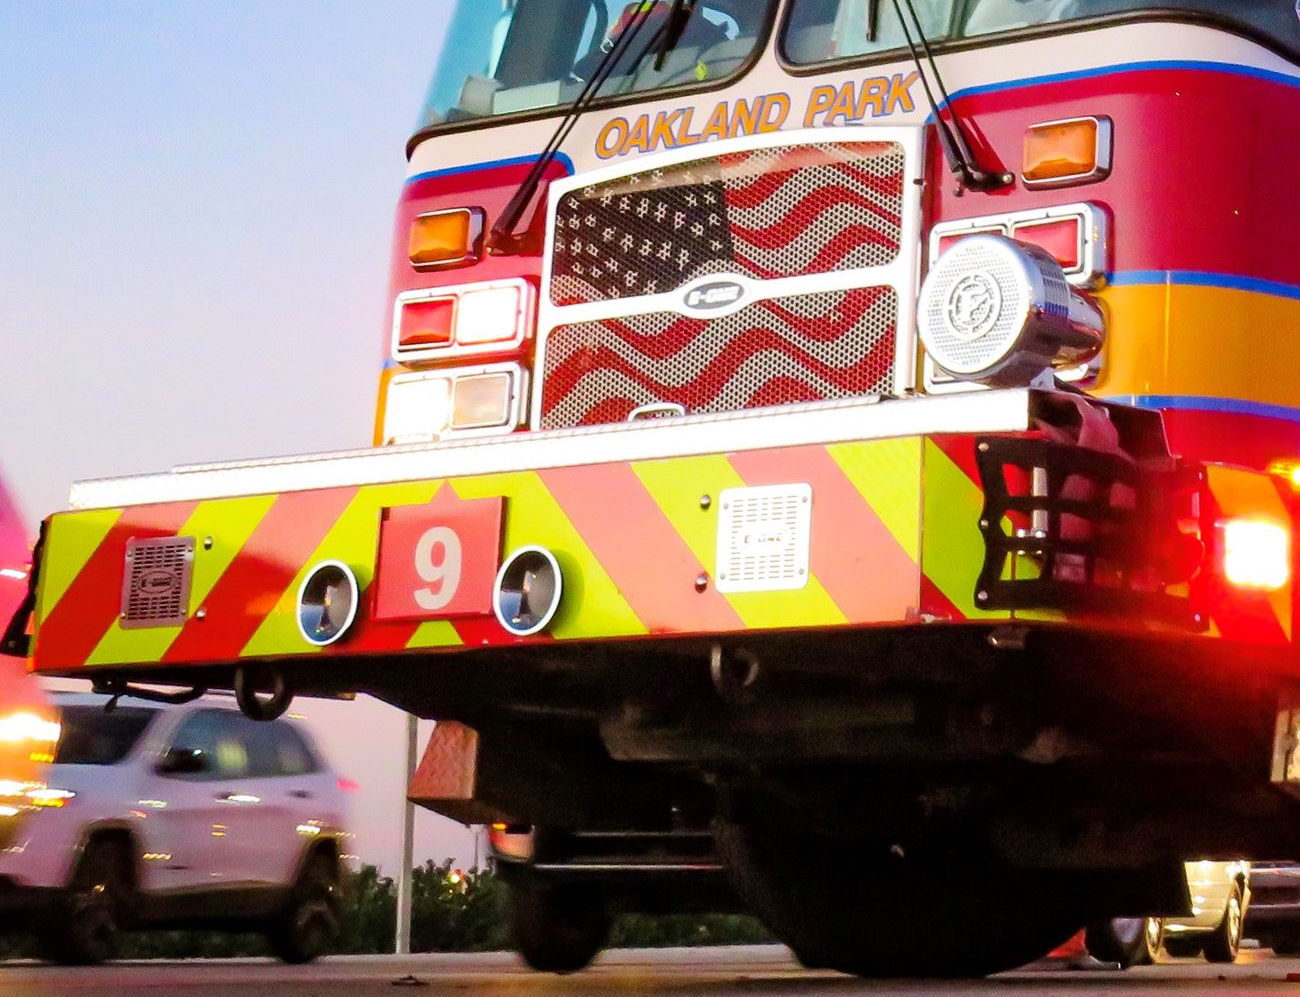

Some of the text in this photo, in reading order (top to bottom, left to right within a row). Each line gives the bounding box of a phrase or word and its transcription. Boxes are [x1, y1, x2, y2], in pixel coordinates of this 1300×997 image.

[594, 71, 920, 160] OAKLAND PARK
[413, 525, 462, 610] 9
